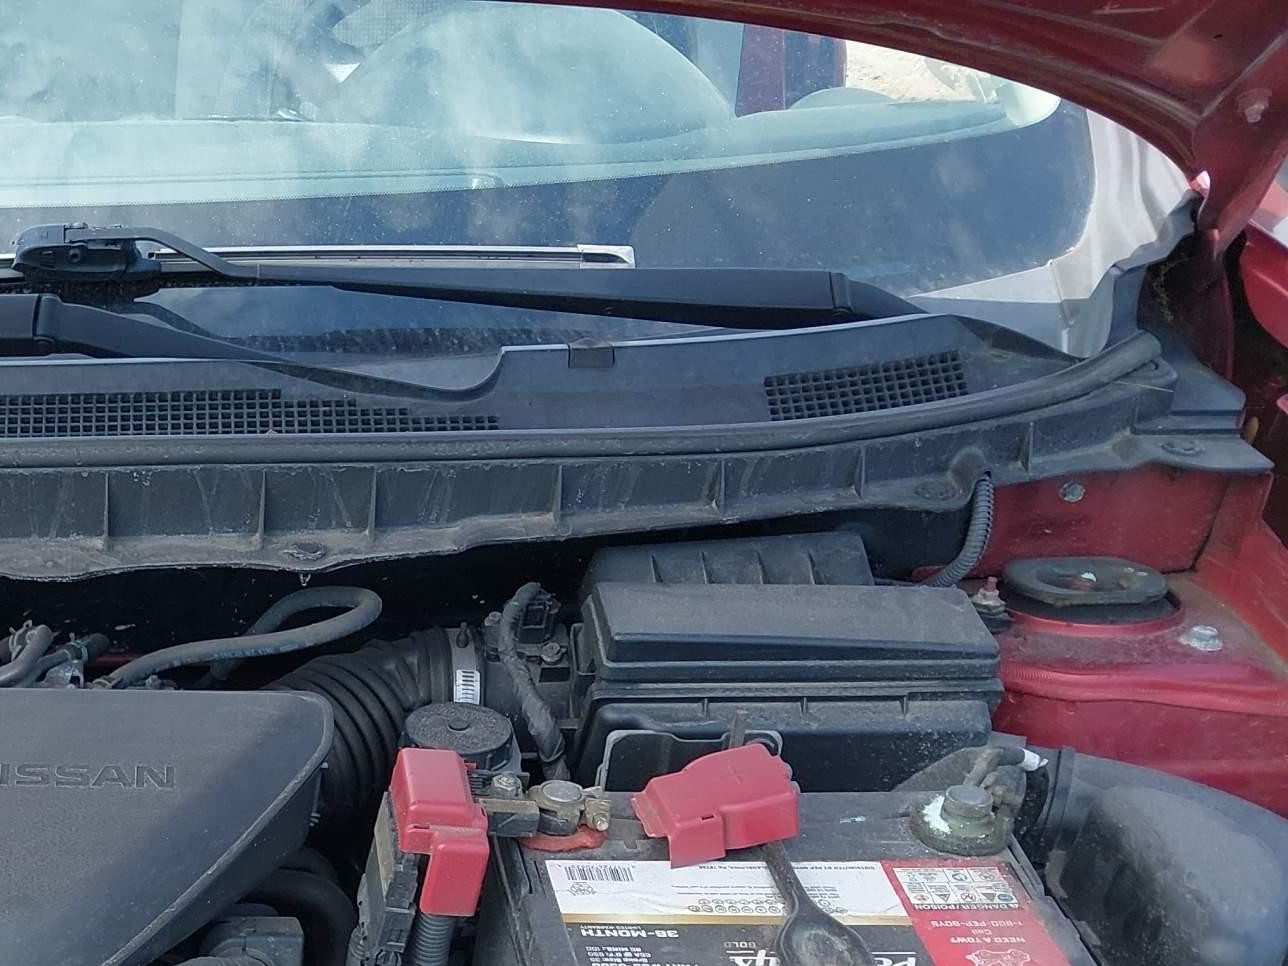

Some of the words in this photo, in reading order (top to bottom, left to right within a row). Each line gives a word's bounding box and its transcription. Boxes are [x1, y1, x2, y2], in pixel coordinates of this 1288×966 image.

[580, 929, 680, 938] 36-MONTH
[971, 928, 992, 936] Call
[950, 936, 983, 944] TOW?
[723, 941, 757, 949] GOLD
